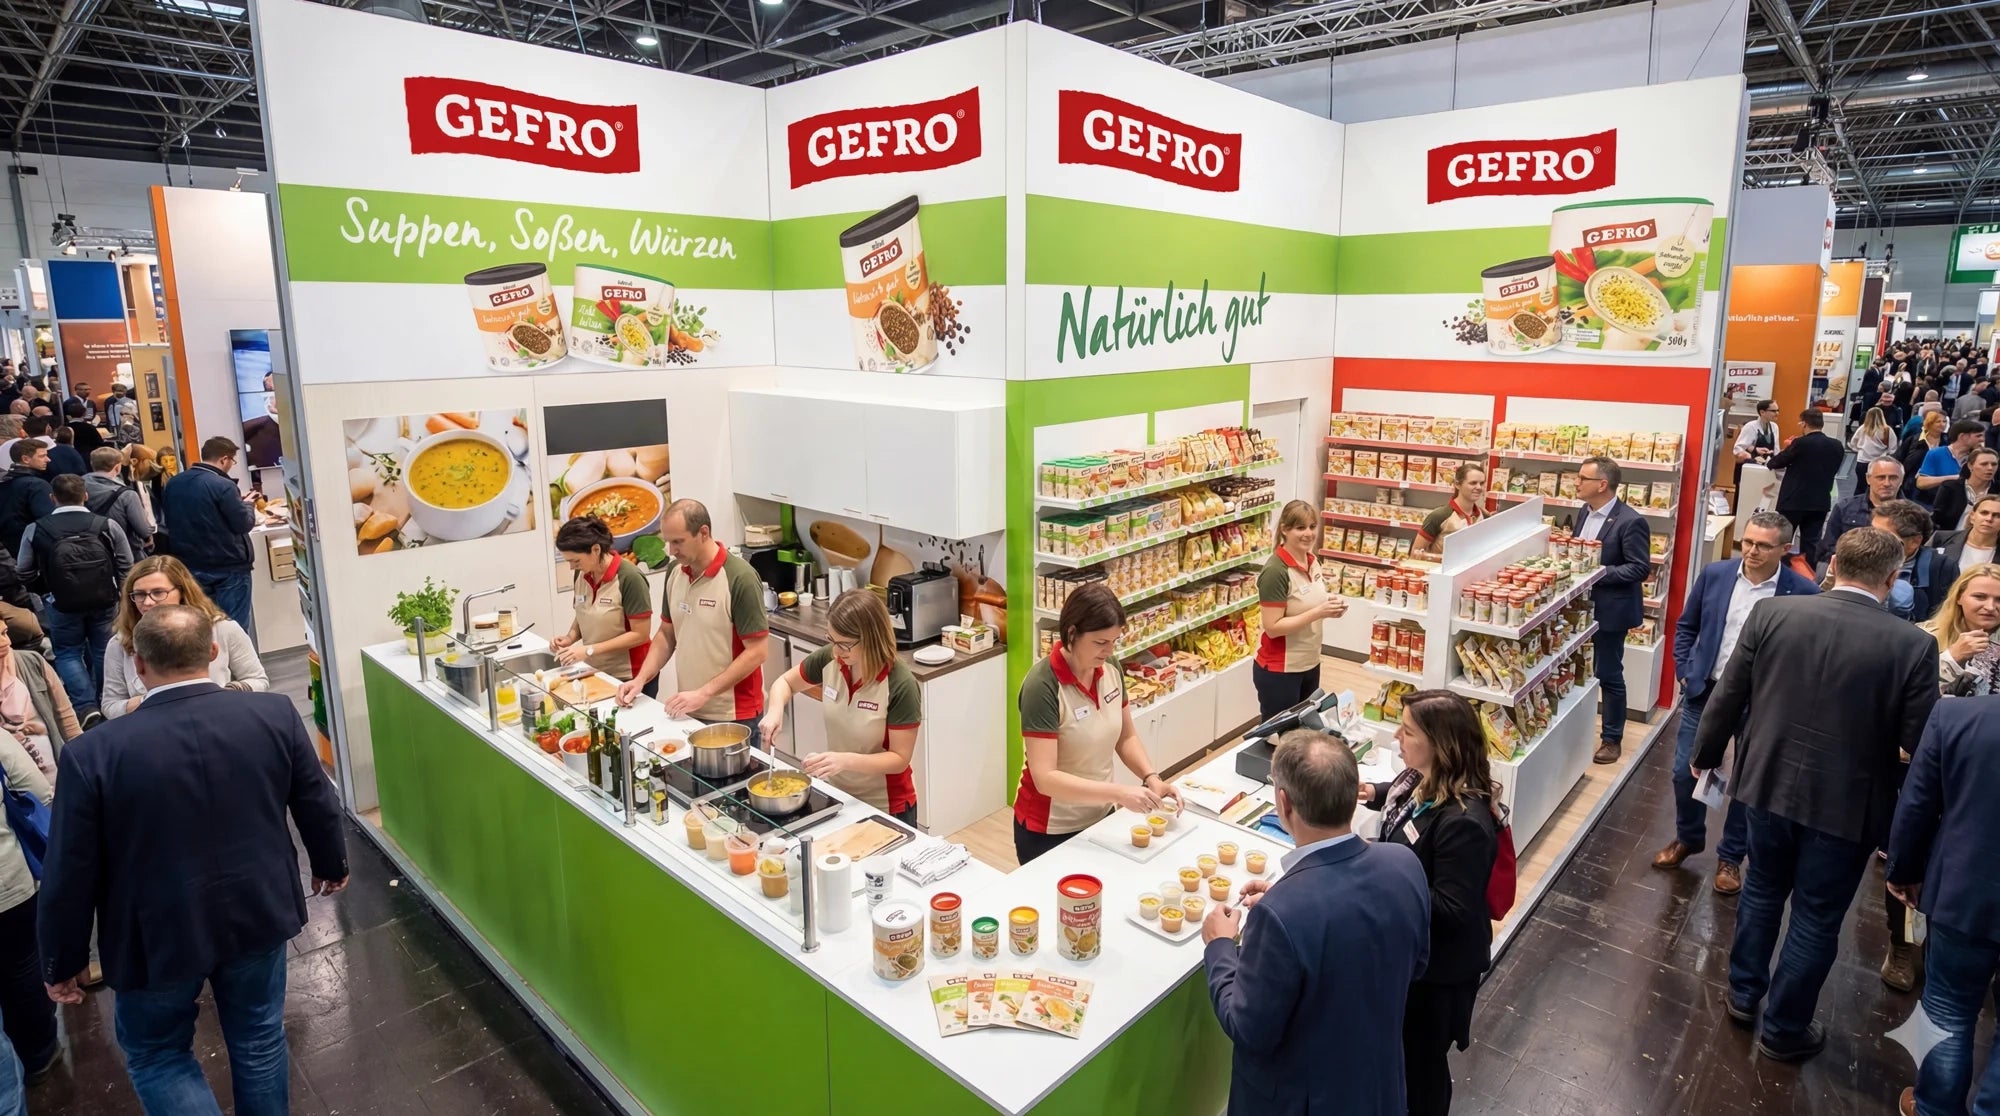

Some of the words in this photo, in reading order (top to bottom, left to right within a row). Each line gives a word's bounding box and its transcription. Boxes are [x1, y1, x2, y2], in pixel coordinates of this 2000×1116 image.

[435, 94, 617, 158] GEFRO
[807, 113, 958, 168] GEFRO
[1083, 109, 1225, 178] GEFRO
[1447, 148, 1595, 188] GEFRO
[340, 197, 496, 258] Suppen,
[510, 208, 618, 262] Soßen,
[629, 218, 737, 260] Würzen
[492, 288, 530, 305] GEFRO
[604, 288, 643, 300] GEFRO
[1057, 278, 1217, 364] Natürlich
[1222, 271, 1271, 363] gut
